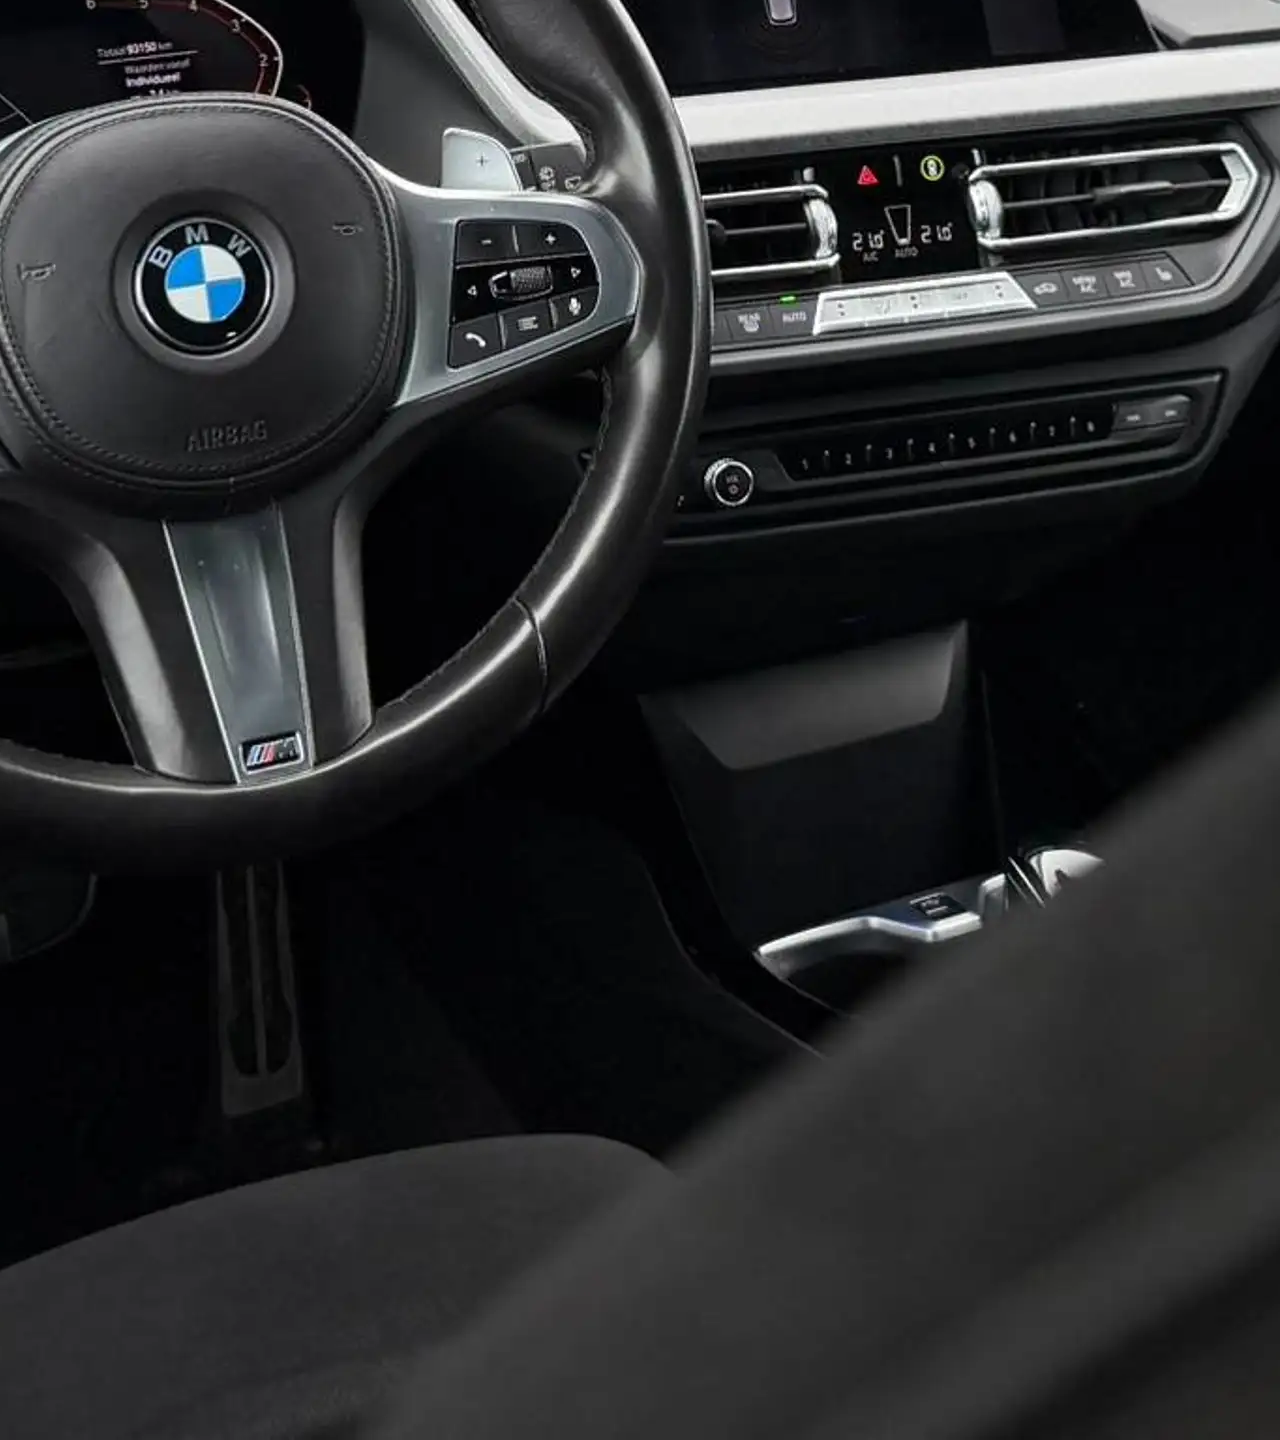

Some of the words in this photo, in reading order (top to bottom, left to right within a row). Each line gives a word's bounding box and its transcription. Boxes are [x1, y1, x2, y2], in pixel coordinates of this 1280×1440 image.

[231, 20, 241, 33] 3
[259, 53, 269, 67] 2
[149, 224, 251, 269] BMW
[187, 420, 268, 453] AIRBAG
